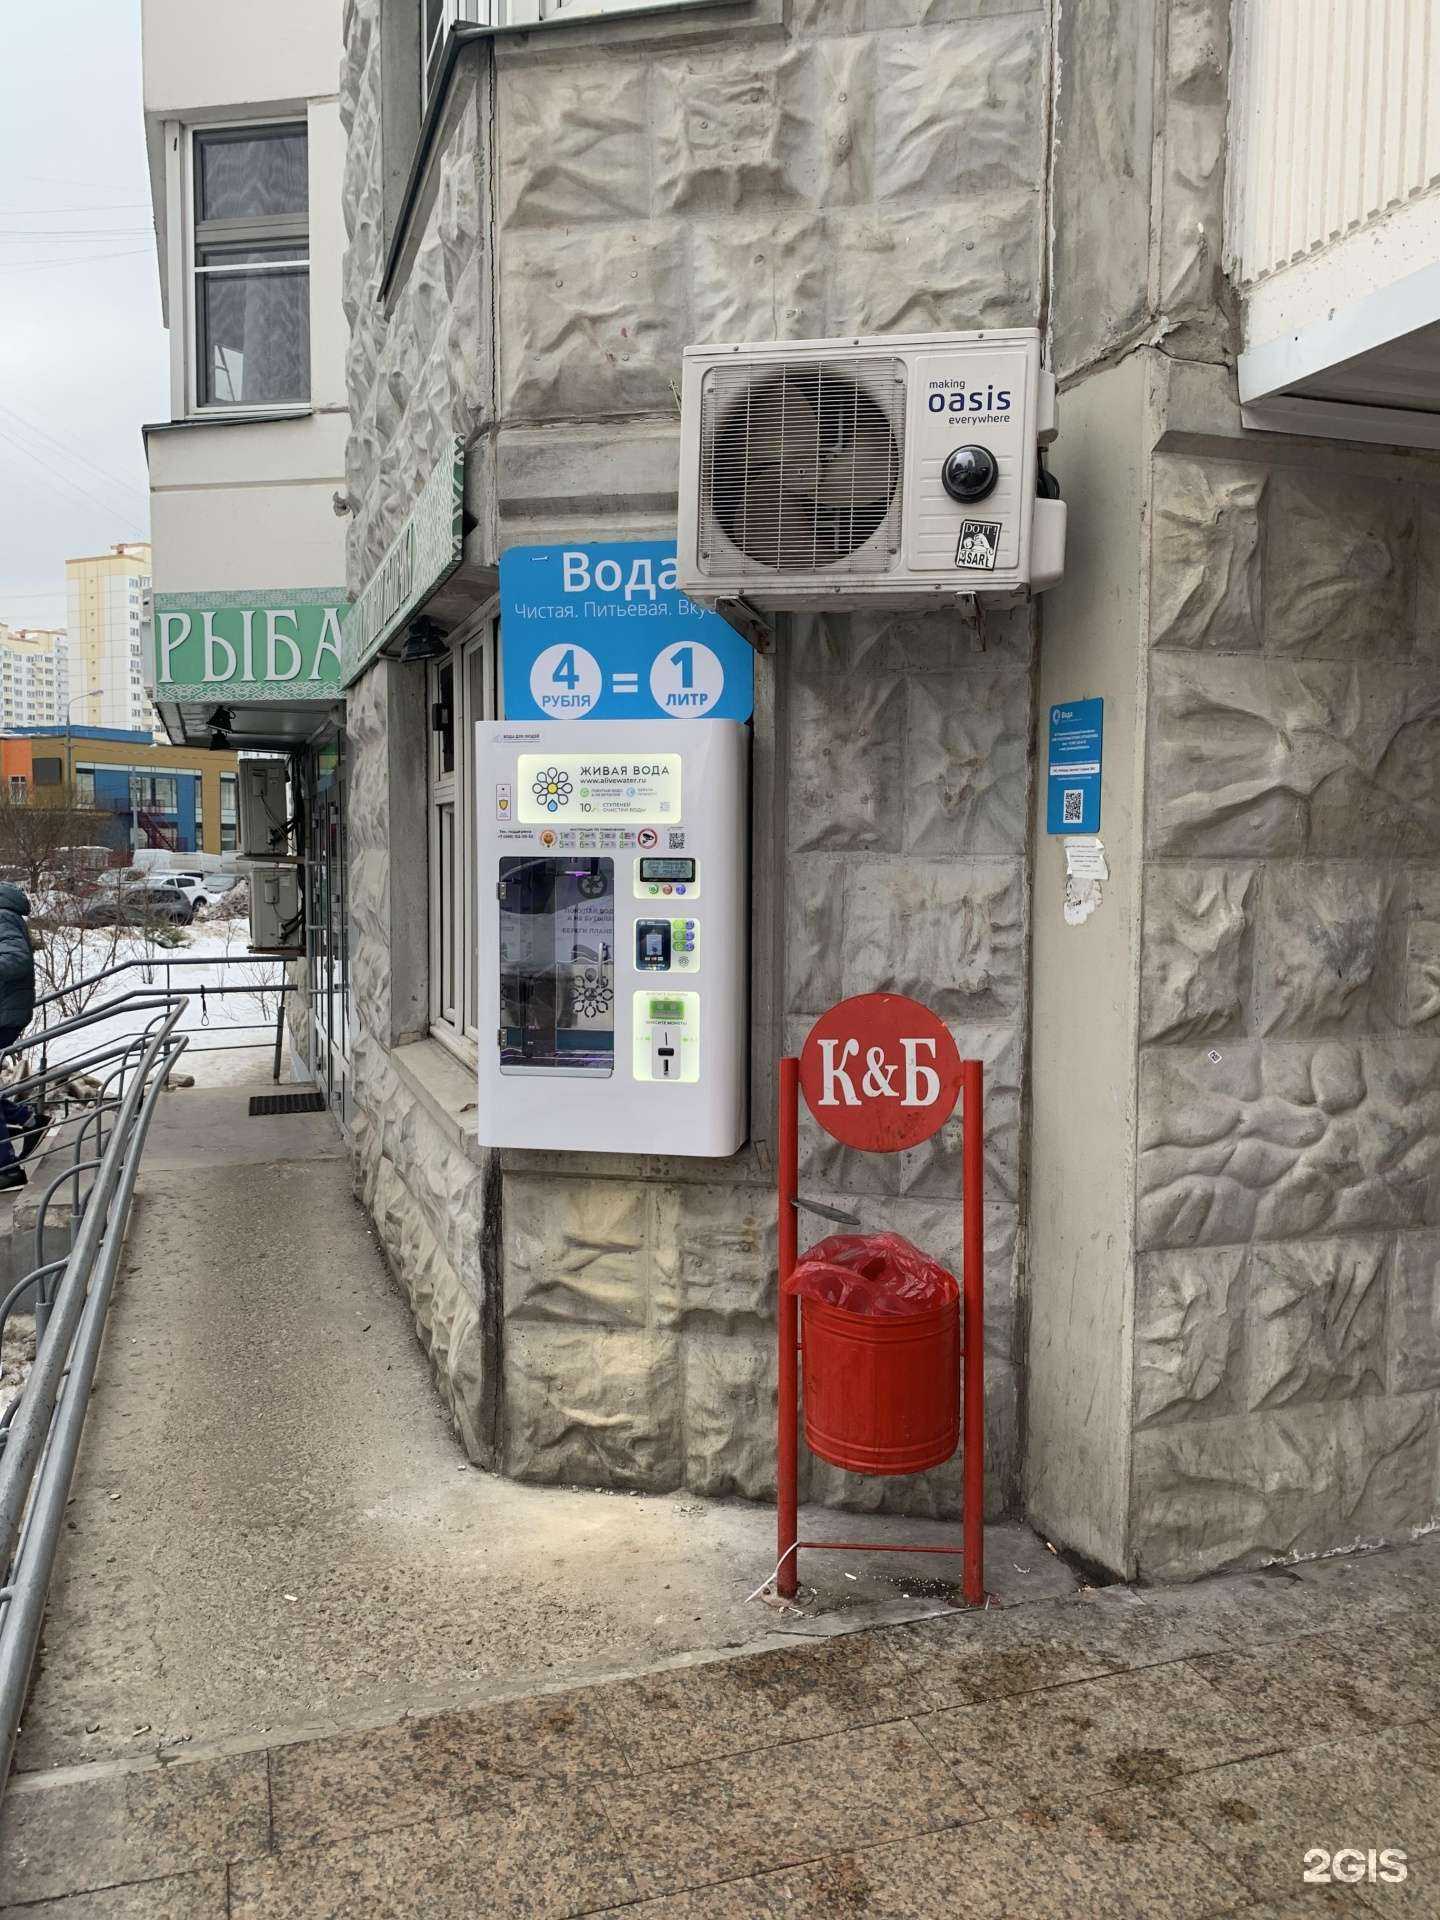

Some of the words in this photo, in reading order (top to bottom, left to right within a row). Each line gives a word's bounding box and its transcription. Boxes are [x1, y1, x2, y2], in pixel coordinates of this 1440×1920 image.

[929, 379, 965, 389] making
[928, 384, 1010, 412] oasis
[948, 414, 1010, 425] everywhere
[965, 523, 980, 534] DO
[562, 551, 679, 600] Вода
[514, 603, 579, 619] Чистая.
[583, 601, 673, 617] Питьевая.
[158, 608, 342, 683] РЫБА
[552, 649, 580, 690] 4
[670, 647, 694, 688] 1
[541, 695, 591, 707] РУБЛЯ
[666, 693, 709, 706] ЛИТР
[580, 766, 628, 776] ЖИВАЯ
[633, 765, 670, 776] ВОДА
[580, 803, 592, 813] 10
[817, 1038, 941, 1106] К&Б
